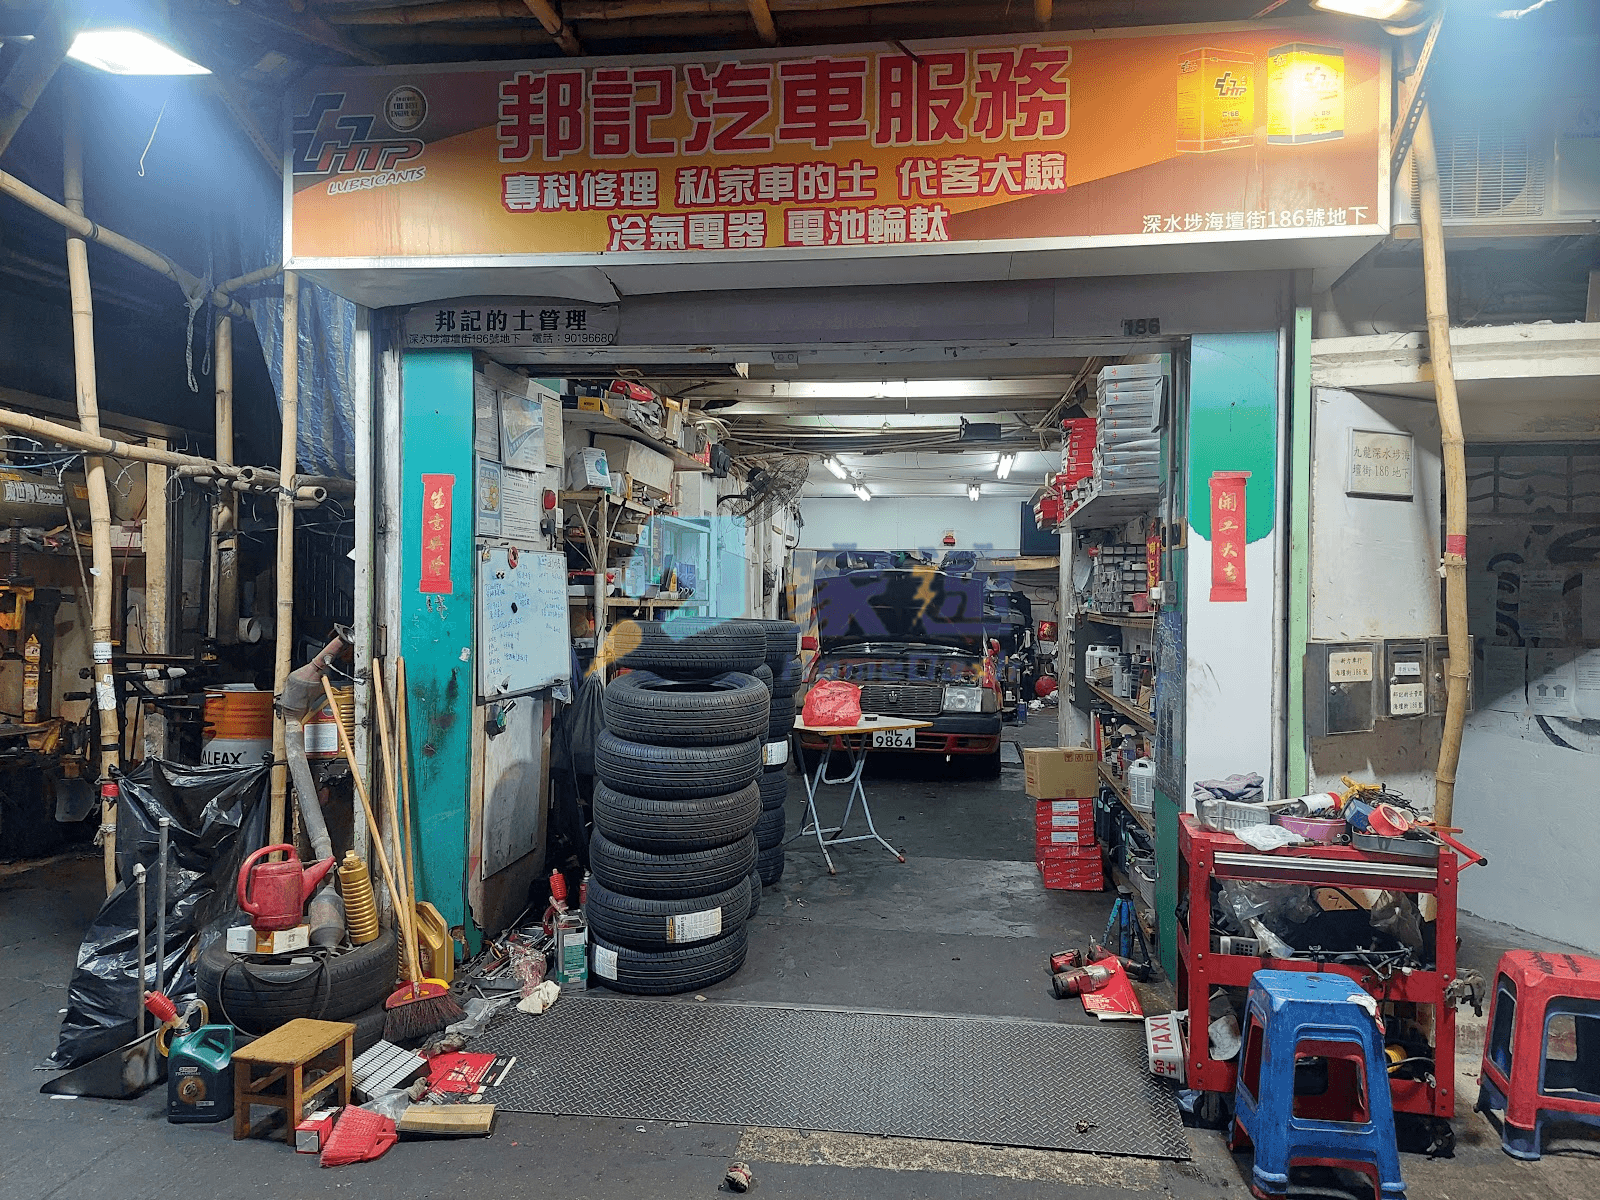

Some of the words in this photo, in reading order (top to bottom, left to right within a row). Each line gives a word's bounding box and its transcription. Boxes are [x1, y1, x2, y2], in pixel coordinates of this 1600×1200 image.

[498, 44, 1072, 162] 邦記汽車服務
[316, 138, 426, 174] HTP
[326, 166, 428, 196] LUBRICANTS
[504, 169, 658, 211] 專科修理
[677, 163, 877, 205] 私家車的士
[899, 153, 1067, 197] 代客大驗
[608, 210, 767, 252] 冷氣電器
[786, 205, 950, 246] 電池輪軚
[1142, 206, 1369, 235] 深水埗海壇街186號地下
[434, 309, 588, 332] 邦記的士管理
[1124, 318, 1160, 335] 186
[1218, 491, 1240, 583] 開工大吉
[875, 735, 913, 747] 9864
[1151, 1016, 1175, 1054] TAXI
[1153, 1059, 1177, 1076] 的士
